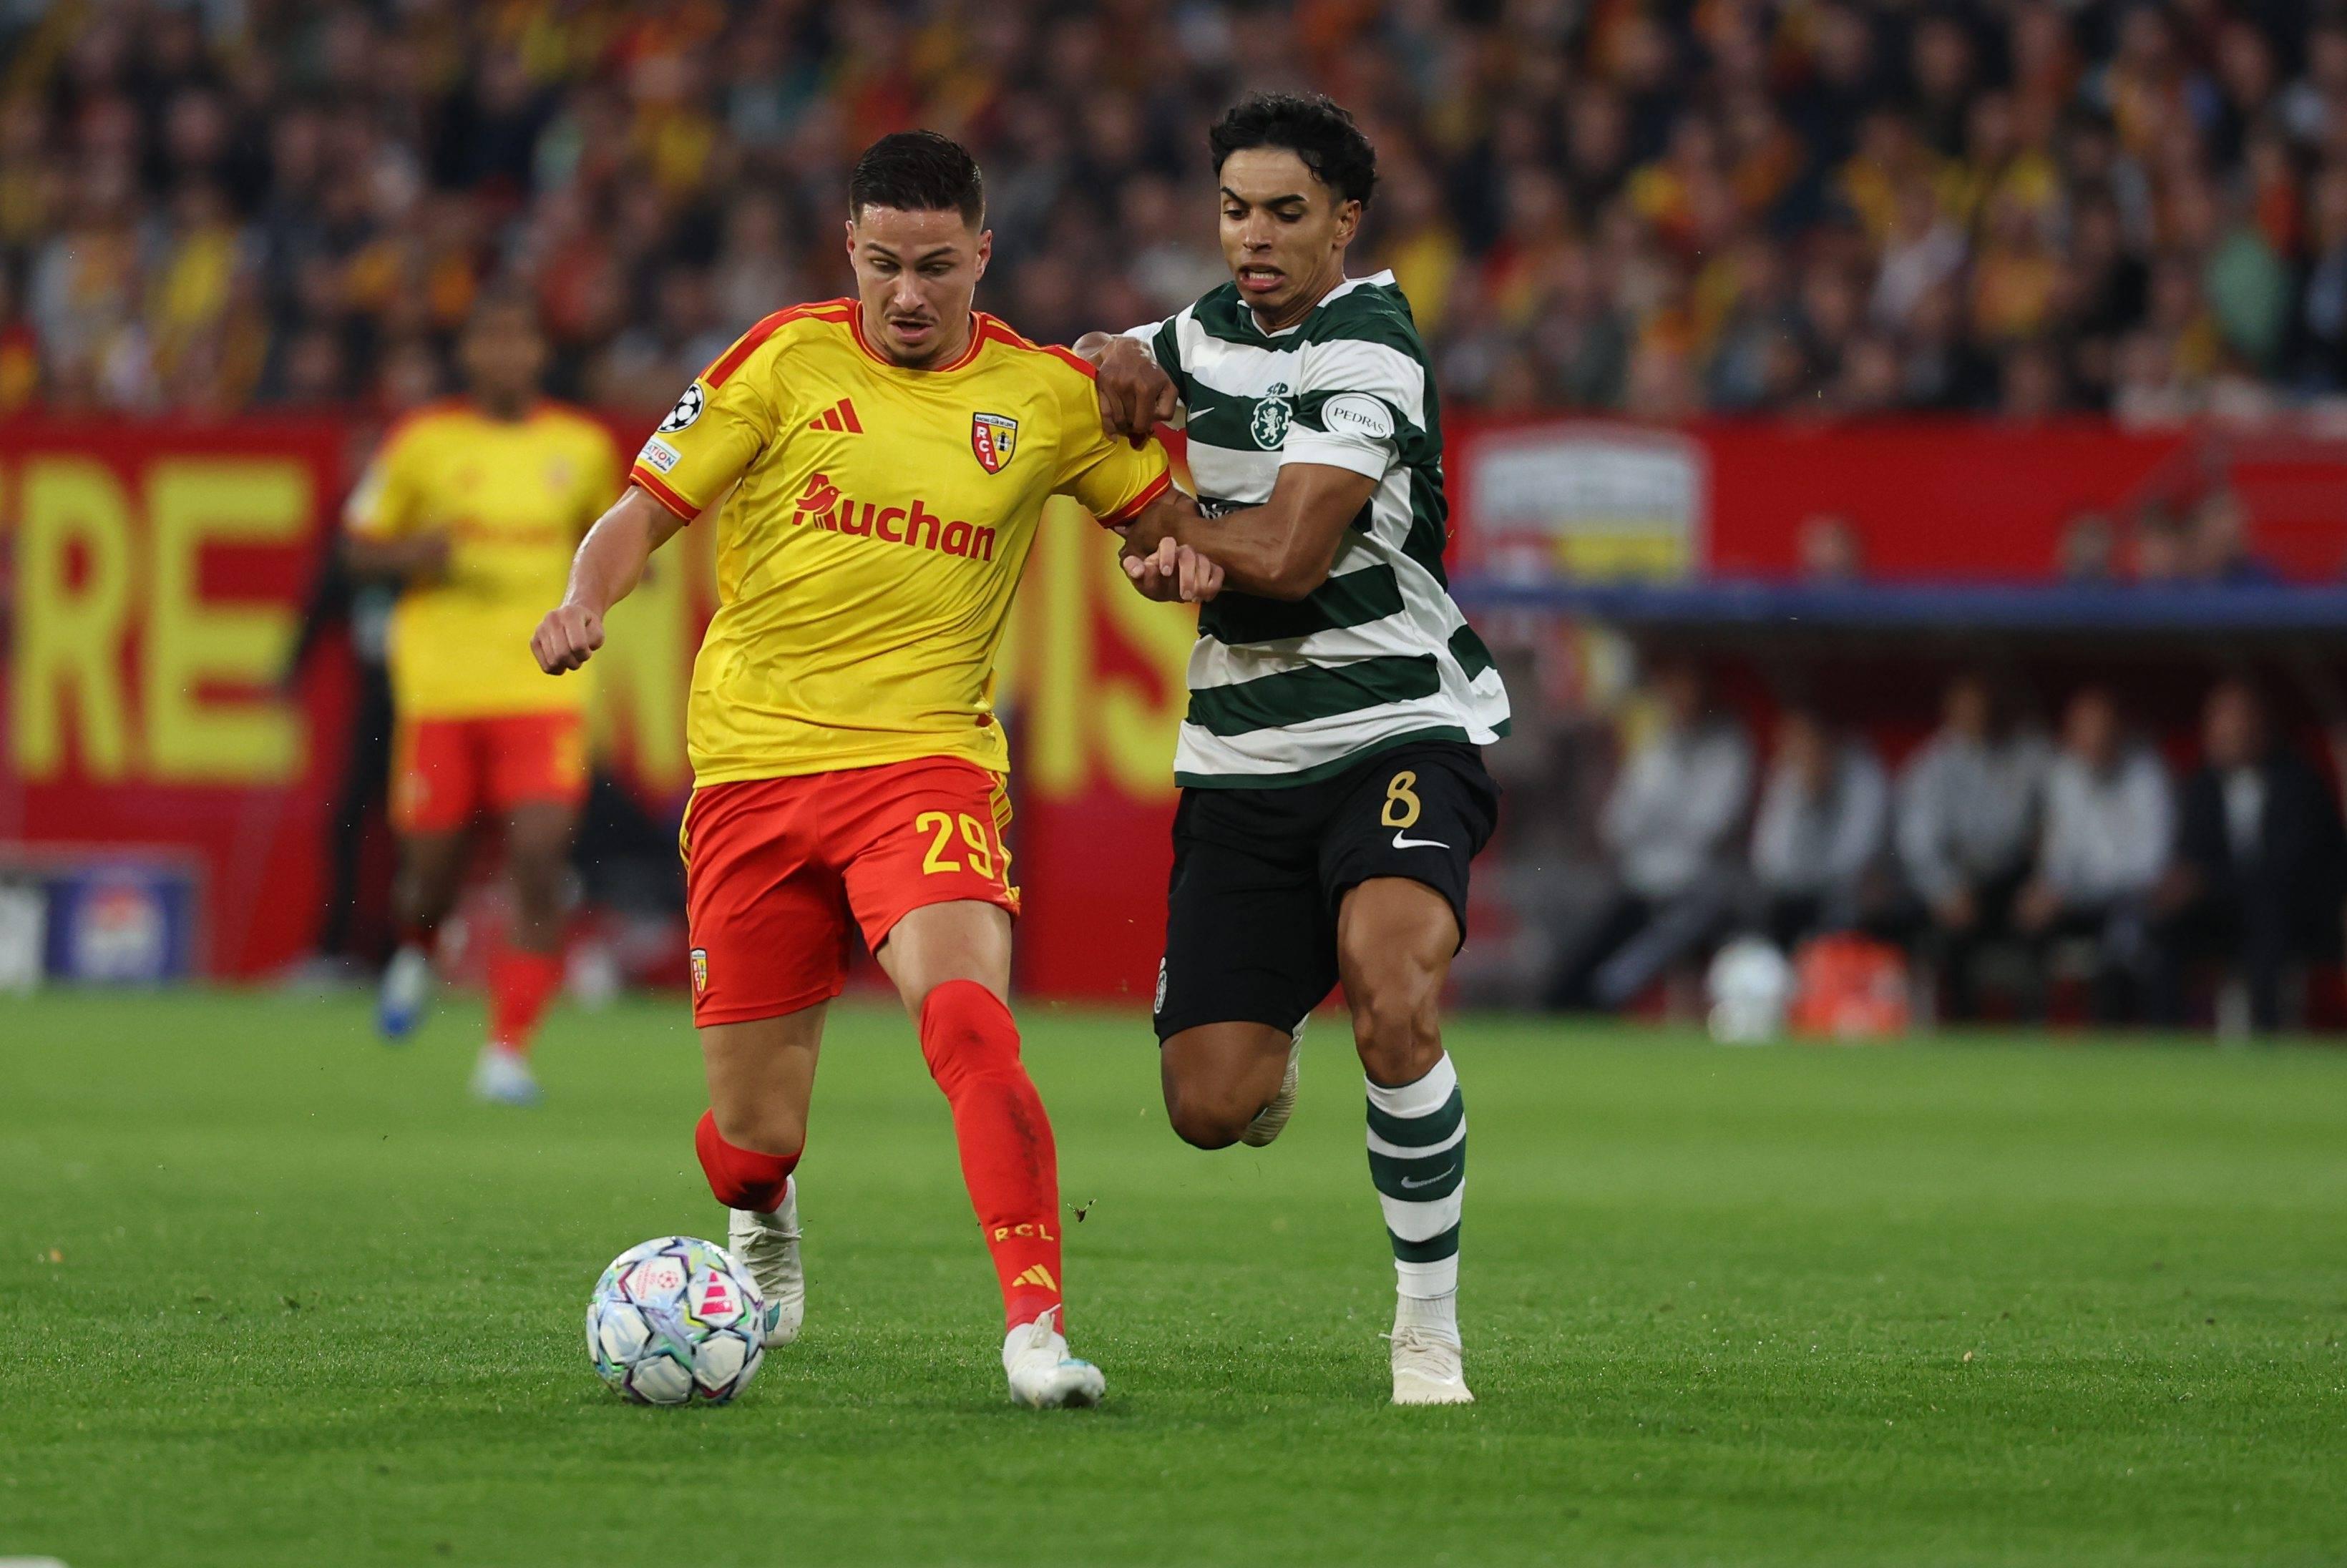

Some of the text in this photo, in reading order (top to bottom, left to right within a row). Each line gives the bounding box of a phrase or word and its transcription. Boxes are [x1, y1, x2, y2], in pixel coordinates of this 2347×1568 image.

[1265, 382, 1289, 396] SCP
[1333, 407, 1385, 433] PEDRAS
[976, 426, 995, 466] RCL
[791, 473, 996, 562] Auchan
[0, 454, 306, 785] RE
[1381, 770, 1421, 829] 8
[915, 810, 995, 881] 29
[994, 1223, 1055, 1242] RCL
